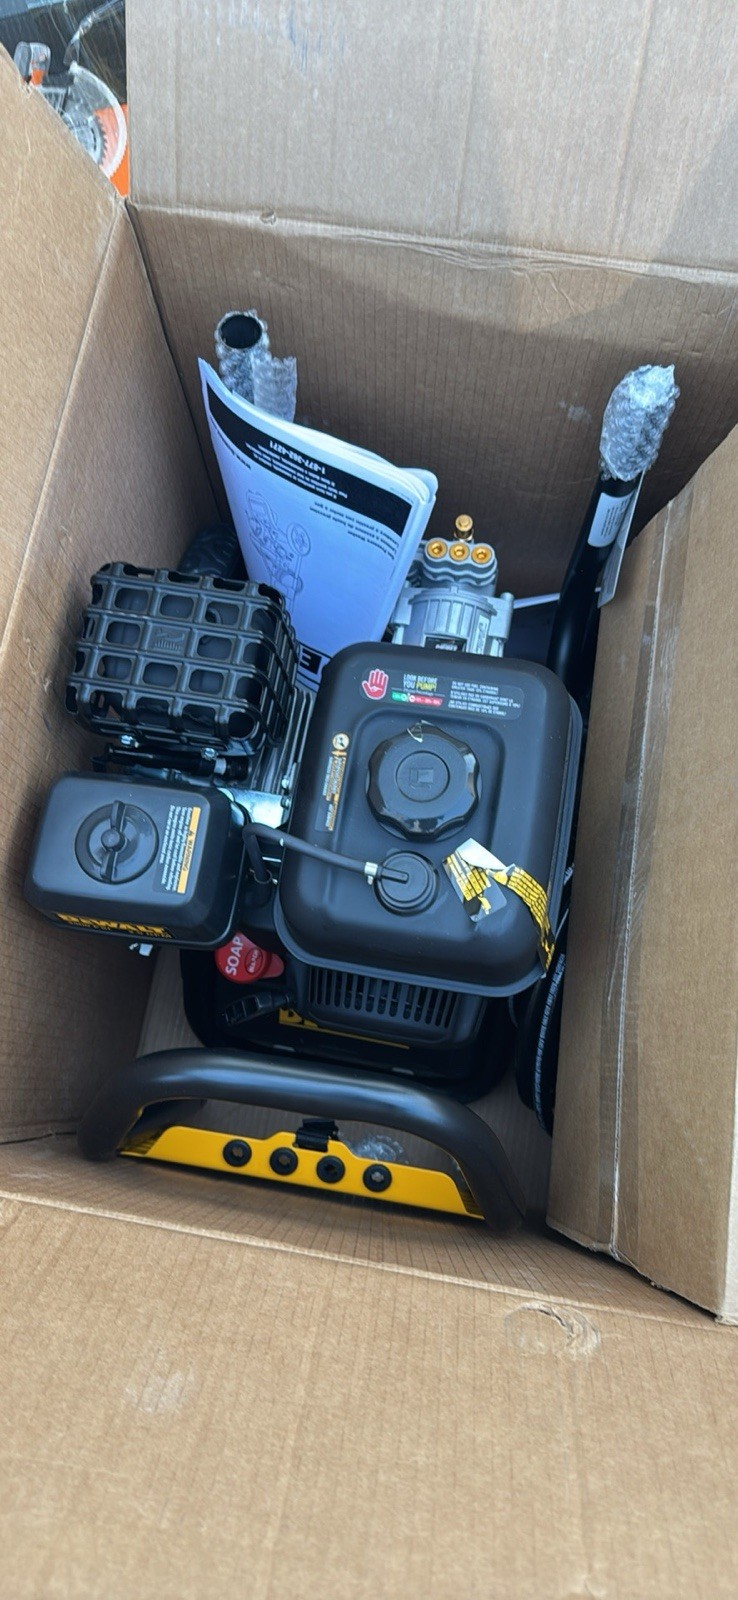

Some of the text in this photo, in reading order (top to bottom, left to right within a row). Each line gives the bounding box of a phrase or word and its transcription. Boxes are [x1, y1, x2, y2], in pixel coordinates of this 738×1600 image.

[403, 674, 437, 684] LOOK BEFORE
[403, 680, 437, 692] YOU PUMP!
[183, 840, 193, 871] WARNING
[55, 912, 166, 935] DEWALT
[225, 936, 243, 975] SOAP
